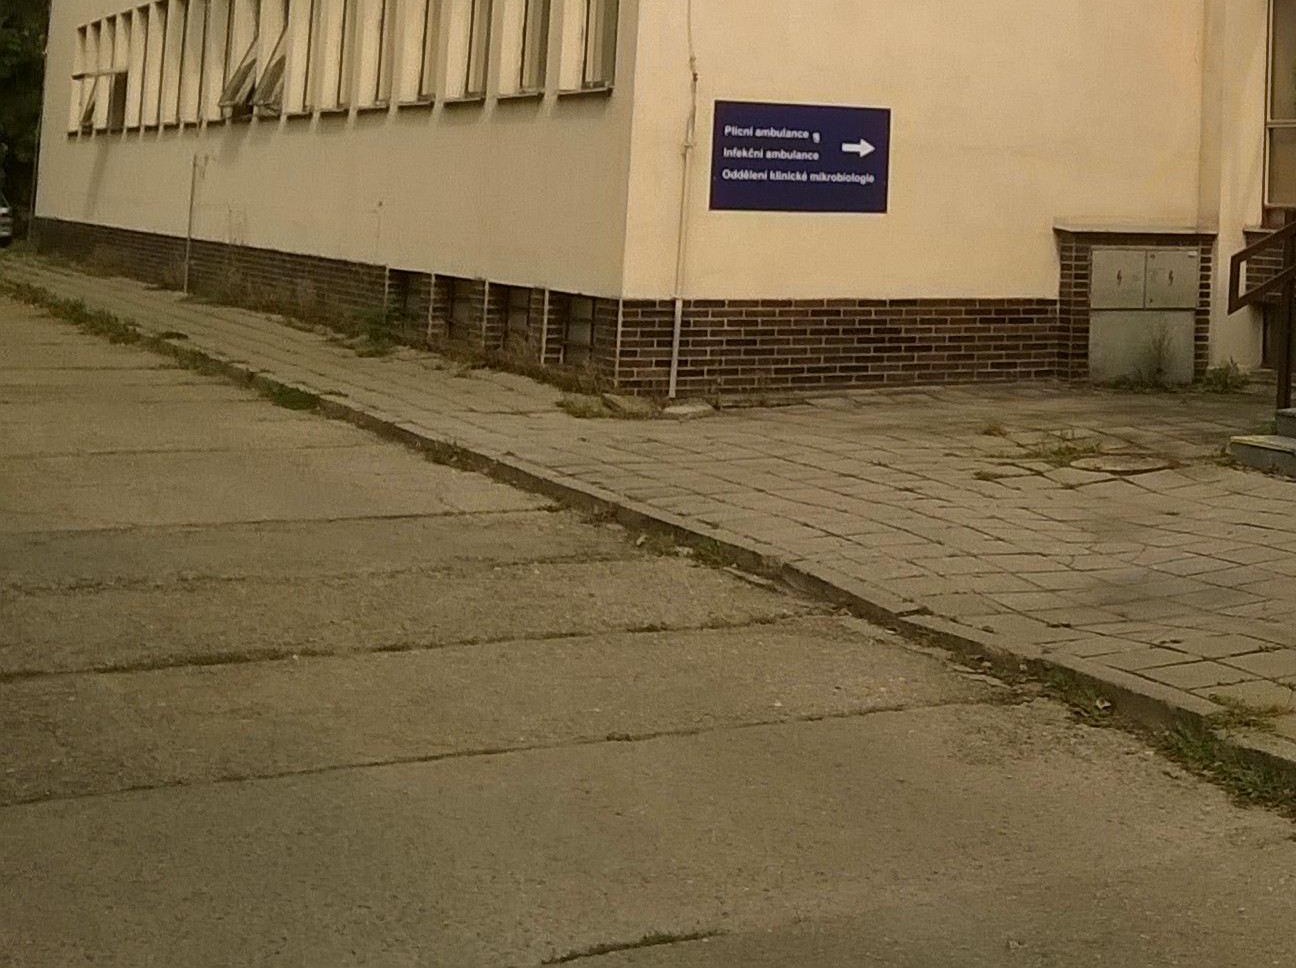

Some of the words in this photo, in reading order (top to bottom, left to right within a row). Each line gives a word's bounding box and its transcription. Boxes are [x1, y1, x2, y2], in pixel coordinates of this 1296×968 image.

[755, 127, 809, 139] ambulance
[723, 147, 764, 159] Infekční
[765, 148, 820, 161] ambulance
[769, 169, 808, 181] klinické
[809, 170, 875, 185] mikrobiologie
